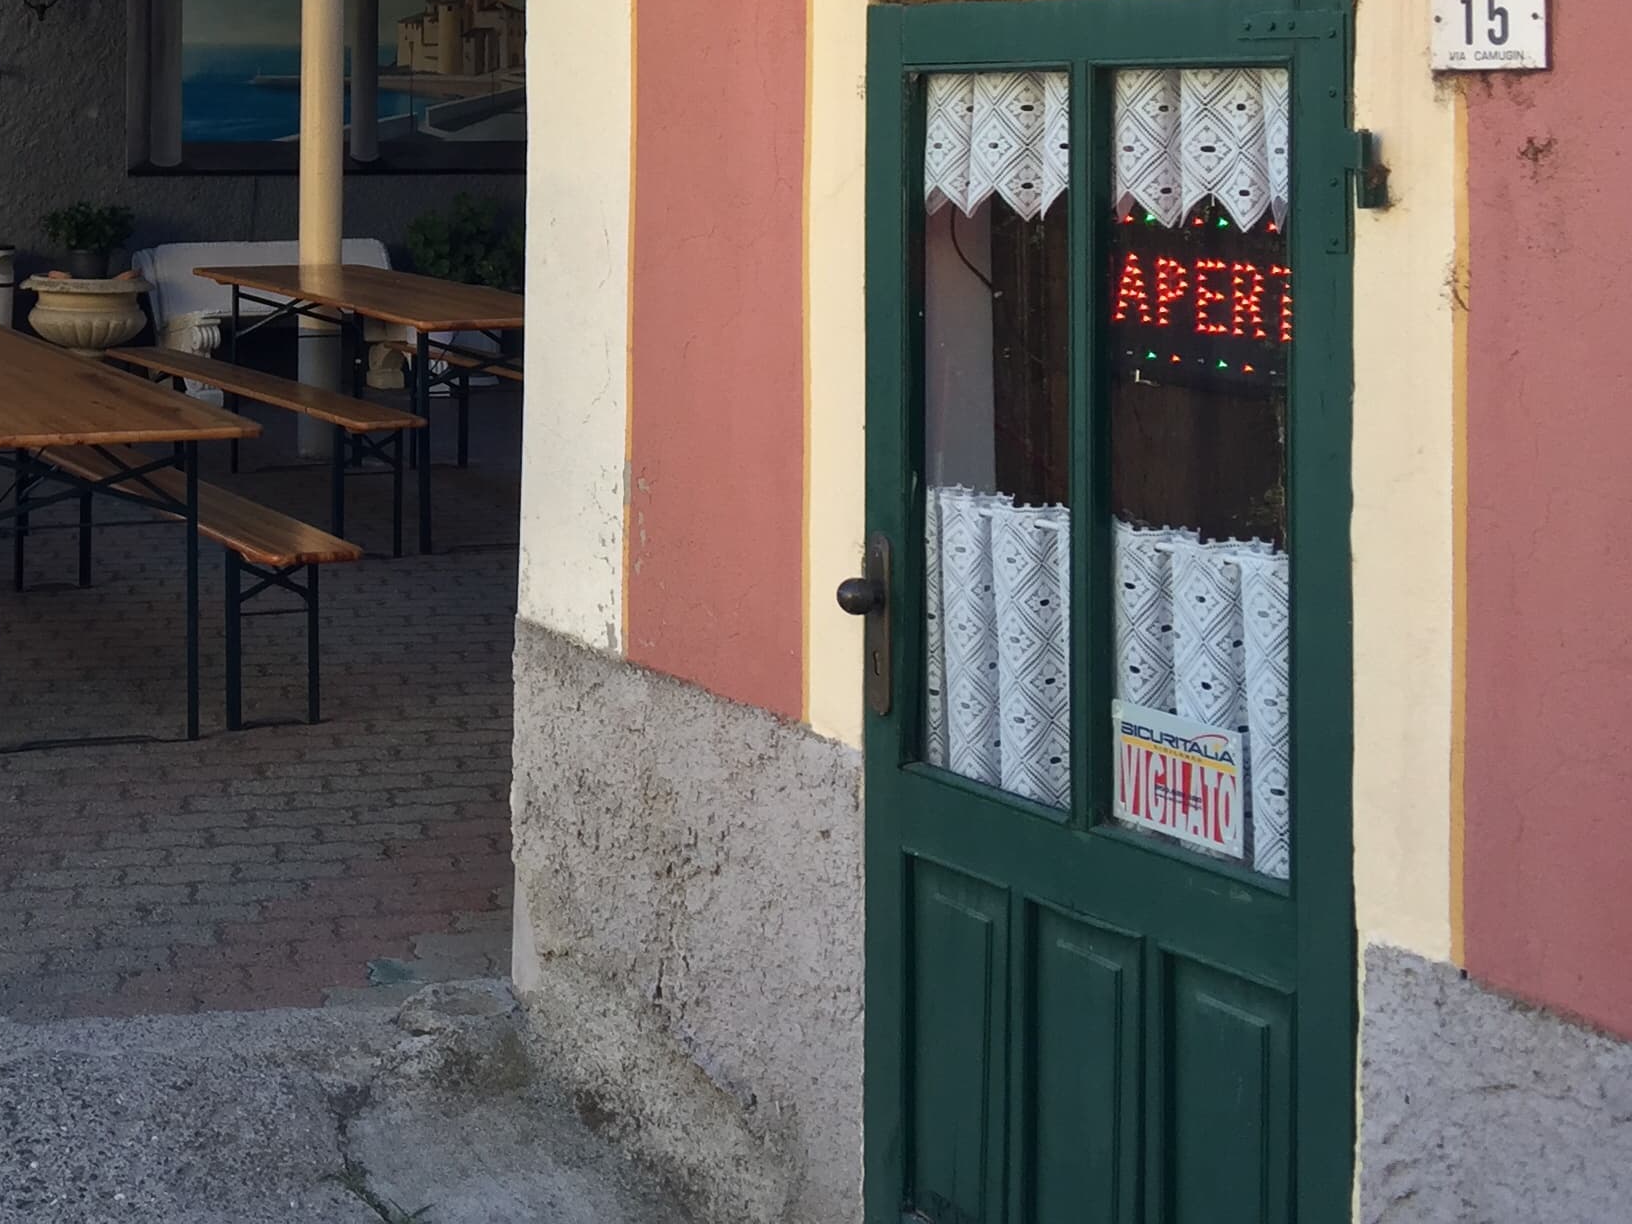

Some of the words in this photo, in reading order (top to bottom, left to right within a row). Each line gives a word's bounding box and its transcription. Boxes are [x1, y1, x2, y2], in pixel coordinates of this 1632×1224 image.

[1449, 51, 1467, 62] VIA
[1474, 50, 1525, 62] CAMUGIN
[1121, 721, 1236, 766] SICURITALIA
[1120, 741, 1237, 844] VIGILATO
